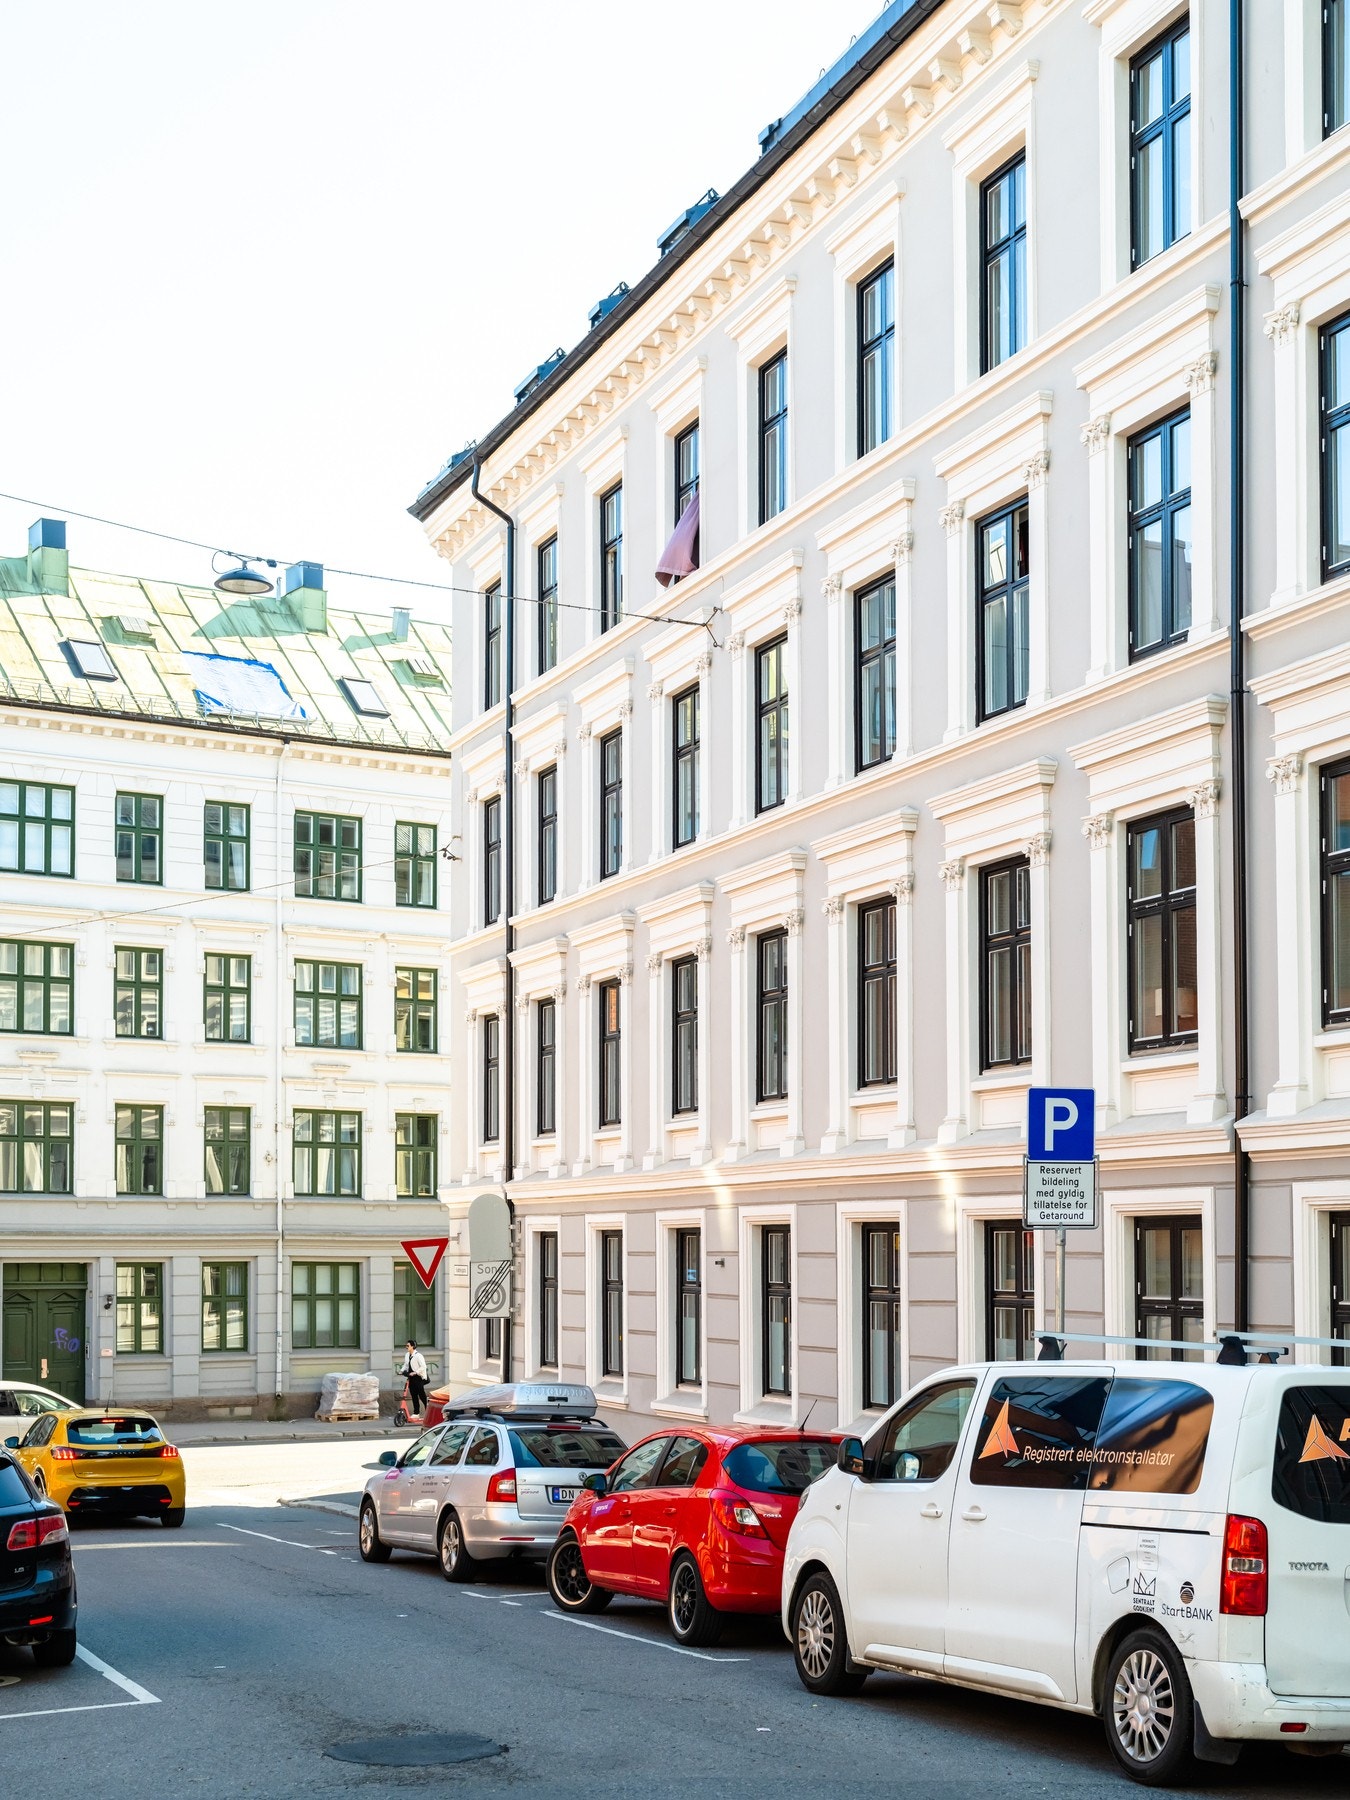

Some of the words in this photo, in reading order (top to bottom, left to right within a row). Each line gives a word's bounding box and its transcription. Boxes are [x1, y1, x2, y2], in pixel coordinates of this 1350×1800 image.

[1044, 1097, 1079, 1151] P
[1039, 1165, 1082, 1175] Reservert
[1041, 1177, 1080, 1188] bildeling
[1036, 1189, 1054, 1197] med
[1058, 1189, 1085, 1199] gyldig
[1033, 1200, 1072, 1209] tillatelse
[1075, 1200, 1088, 1209] for
[1039, 1211, 1084, 1220] Getaround
[477, 1263, 504, 1274] Son
[1022, 1445, 1075, 1464] Registrert
[1076, 1447, 1175, 1466] elektroinstallatør
[561, 1489, 575, 1500] DN
[1288, 1561, 1330, 1571] TOYOTA
[1132, 1597, 1155, 1606] SENTRALT
[1161, 1603, 1213, 1622] StartBANK
